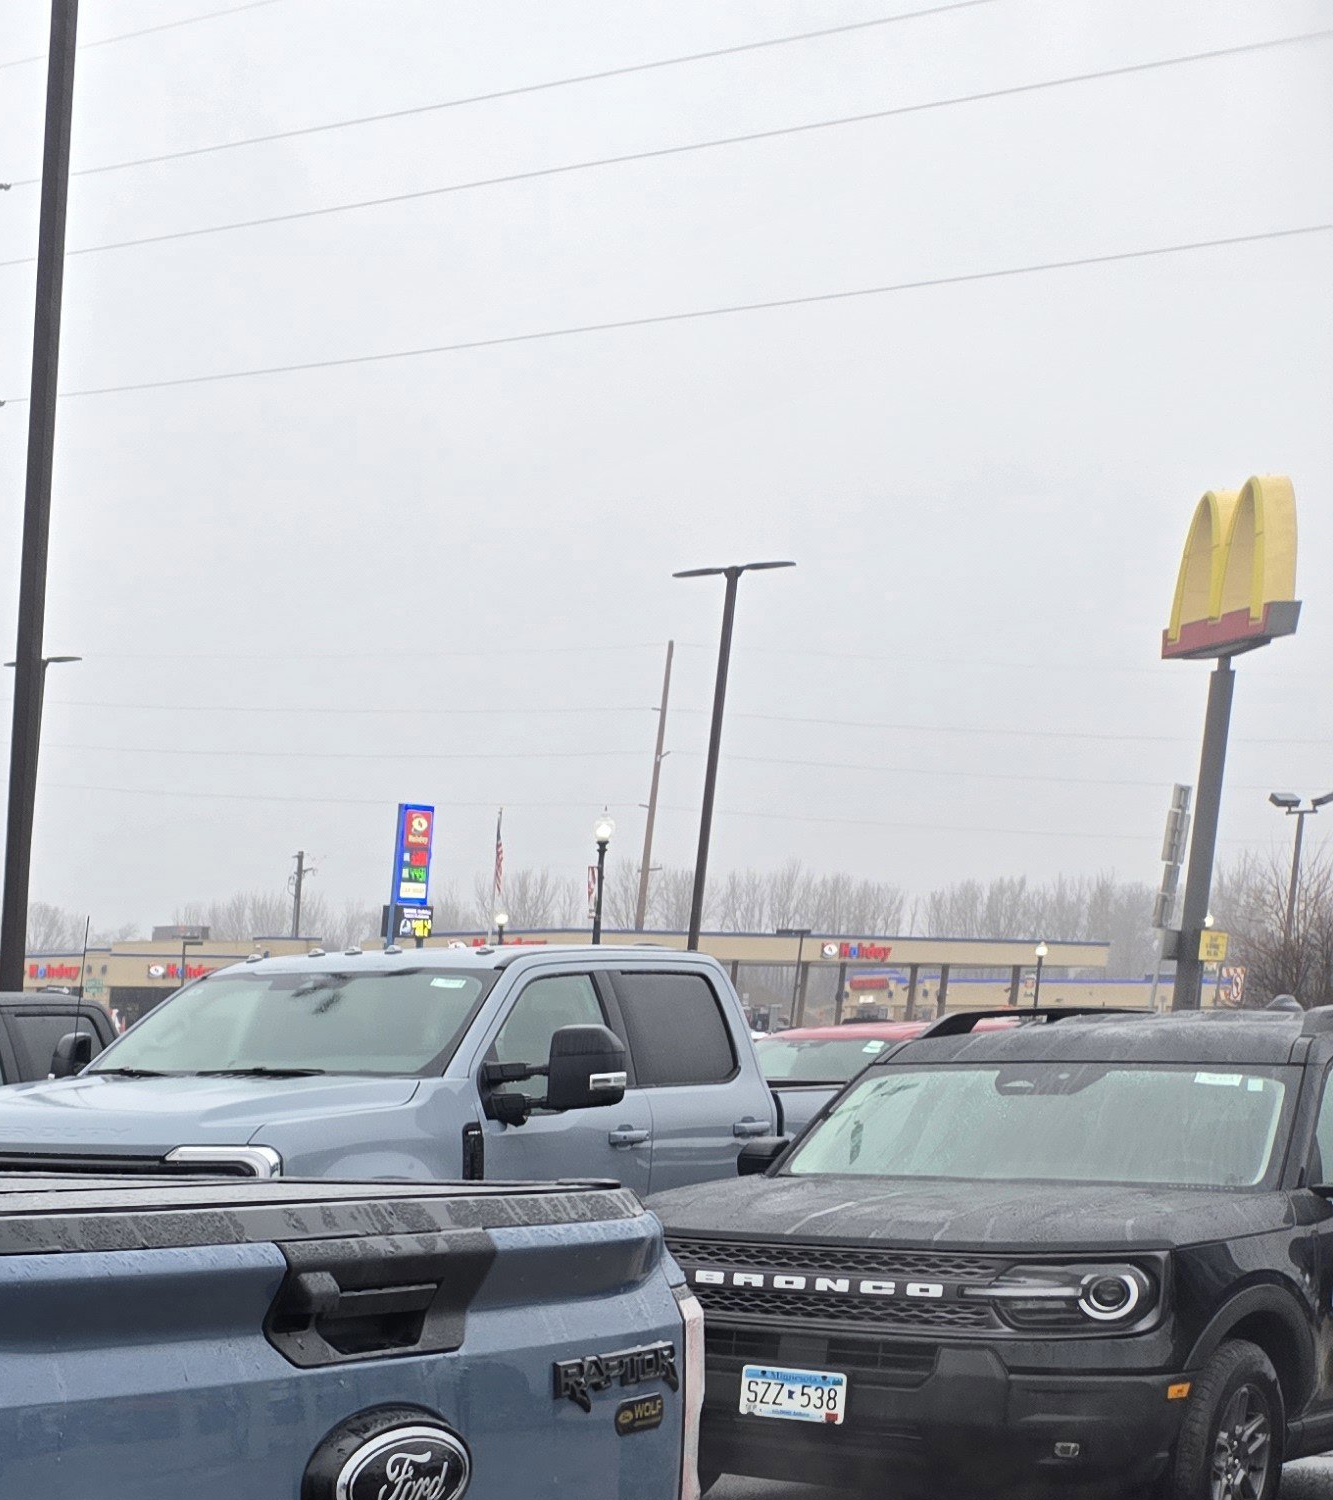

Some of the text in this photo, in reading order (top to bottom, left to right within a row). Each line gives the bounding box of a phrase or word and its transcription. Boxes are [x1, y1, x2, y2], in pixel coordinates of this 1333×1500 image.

[839, 942, 892, 962] Holiday
[29, 963, 81, 980] Holiday
[695, 1269, 944, 1298] BRONCO
[553, 1340, 679, 1413] RAPTOR
[747, 1380, 838, 1410] SZZ 538
[634, 1400, 662, 1419] WOLF
